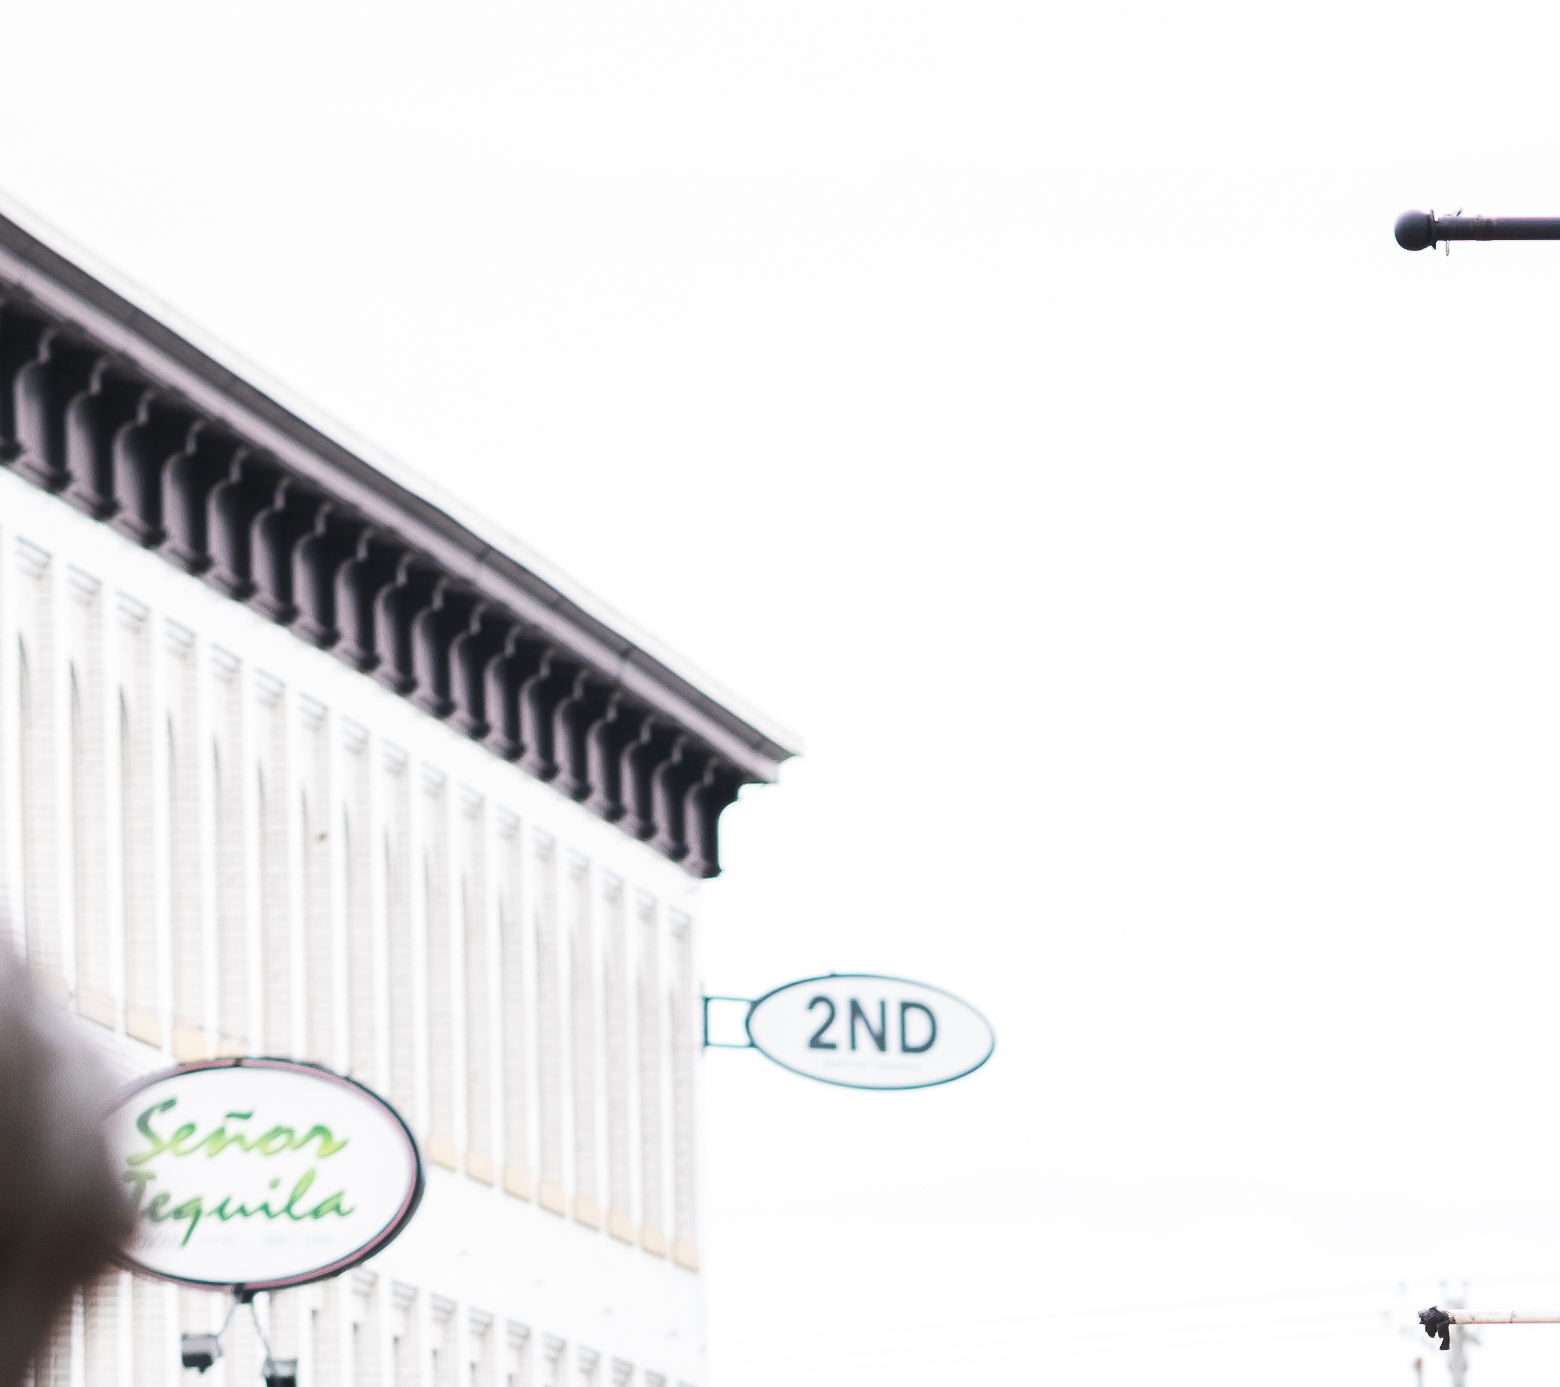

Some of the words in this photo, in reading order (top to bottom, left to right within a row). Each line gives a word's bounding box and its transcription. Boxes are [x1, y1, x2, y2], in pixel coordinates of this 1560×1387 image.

[807, 995, 938, 1054] 2ND
[126, 1097, 349, 1168] Señor
[122, 1168, 355, 1249] Tequila
